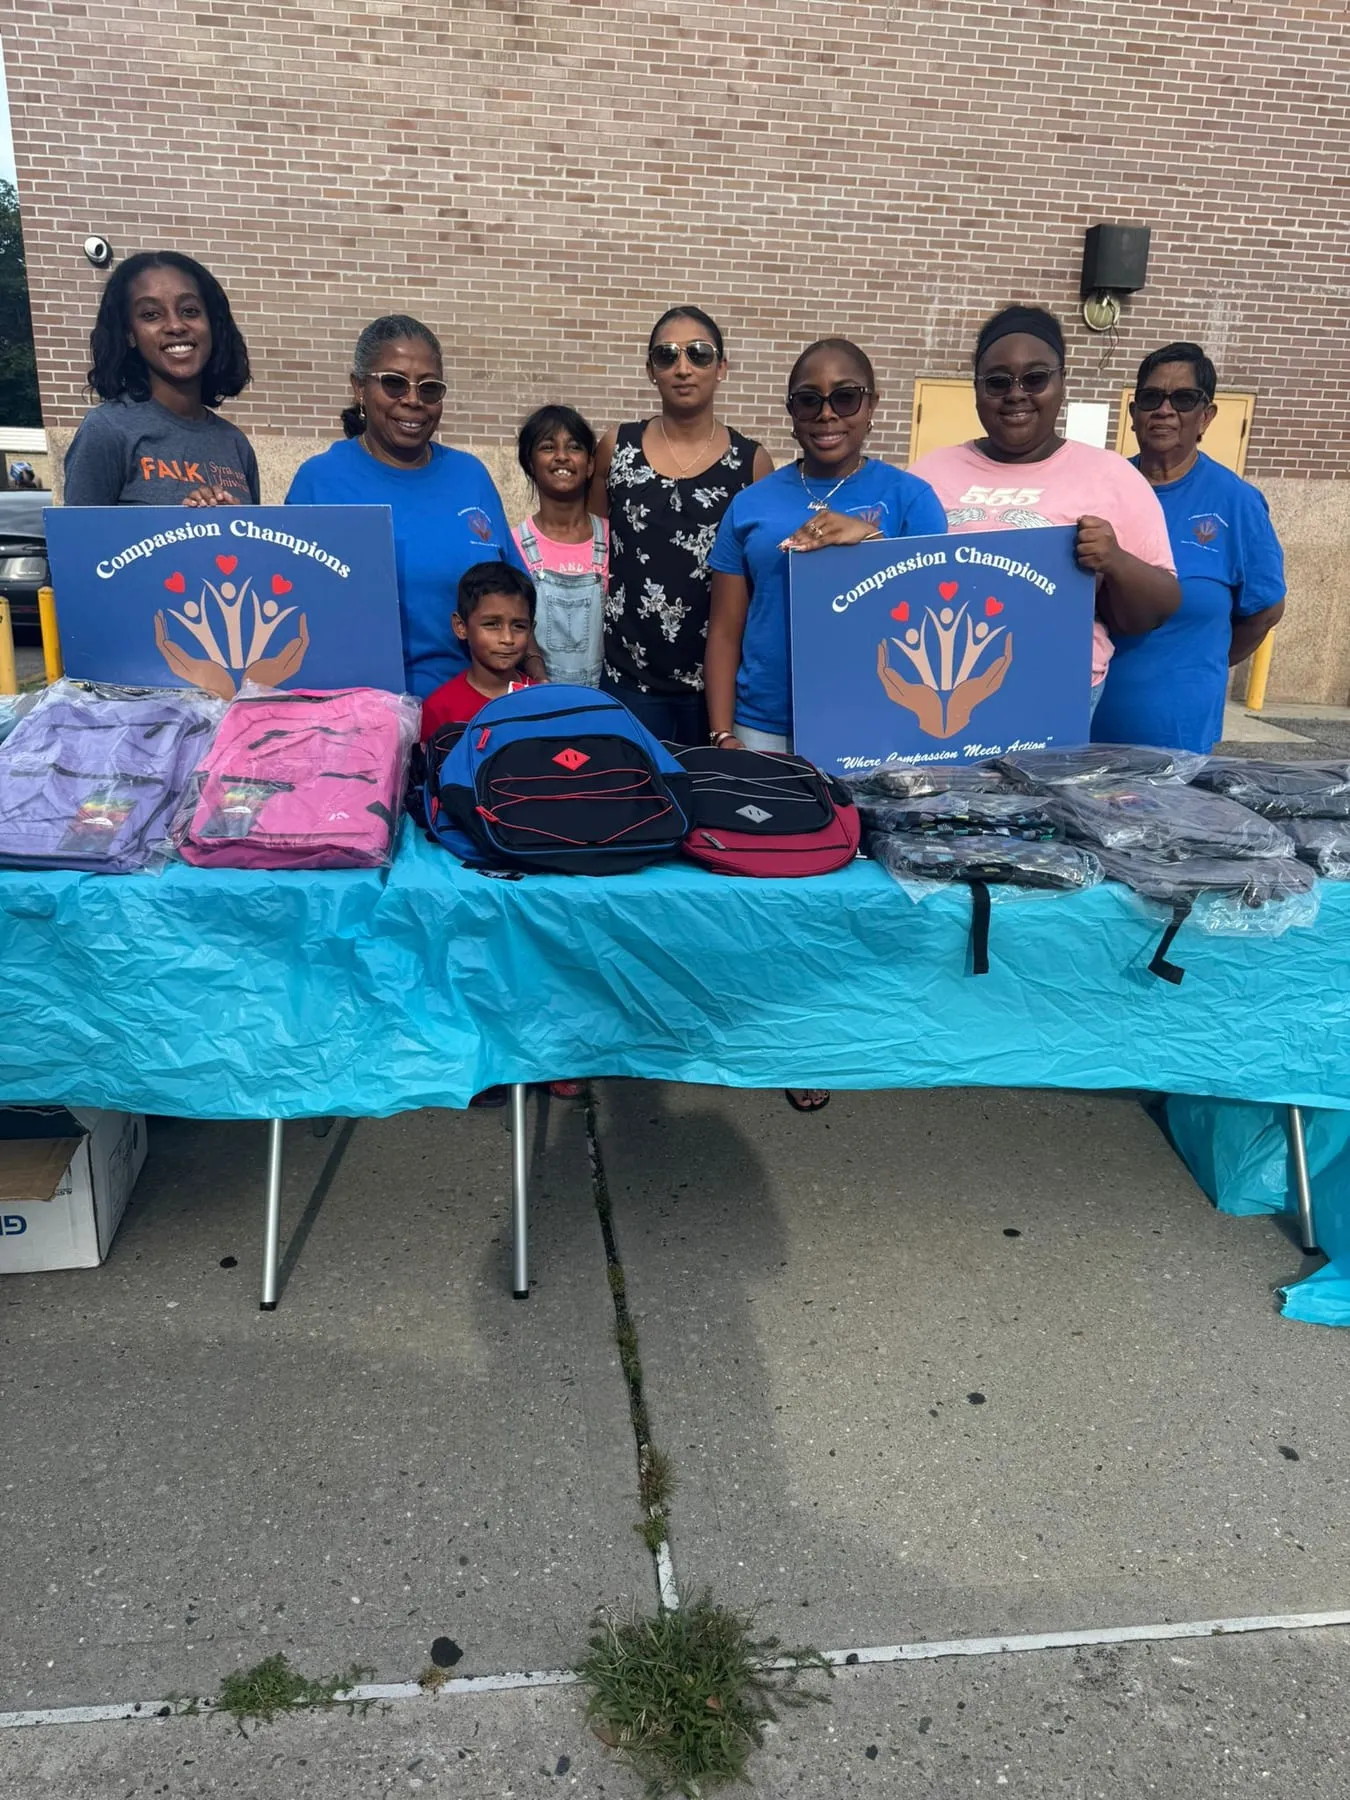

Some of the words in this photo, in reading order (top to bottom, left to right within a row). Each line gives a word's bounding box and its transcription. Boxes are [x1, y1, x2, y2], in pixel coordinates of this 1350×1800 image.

[140, 455, 206, 484] FALK
[959, 485, 1047, 506] 555
[96, 522, 221, 580] Compassion
[229, 519, 351, 578] Champions
[831, 550, 947, 613] Compassion
[954, 546, 1057, 596] Champions
[963, 743, 1001, 758] Meets
